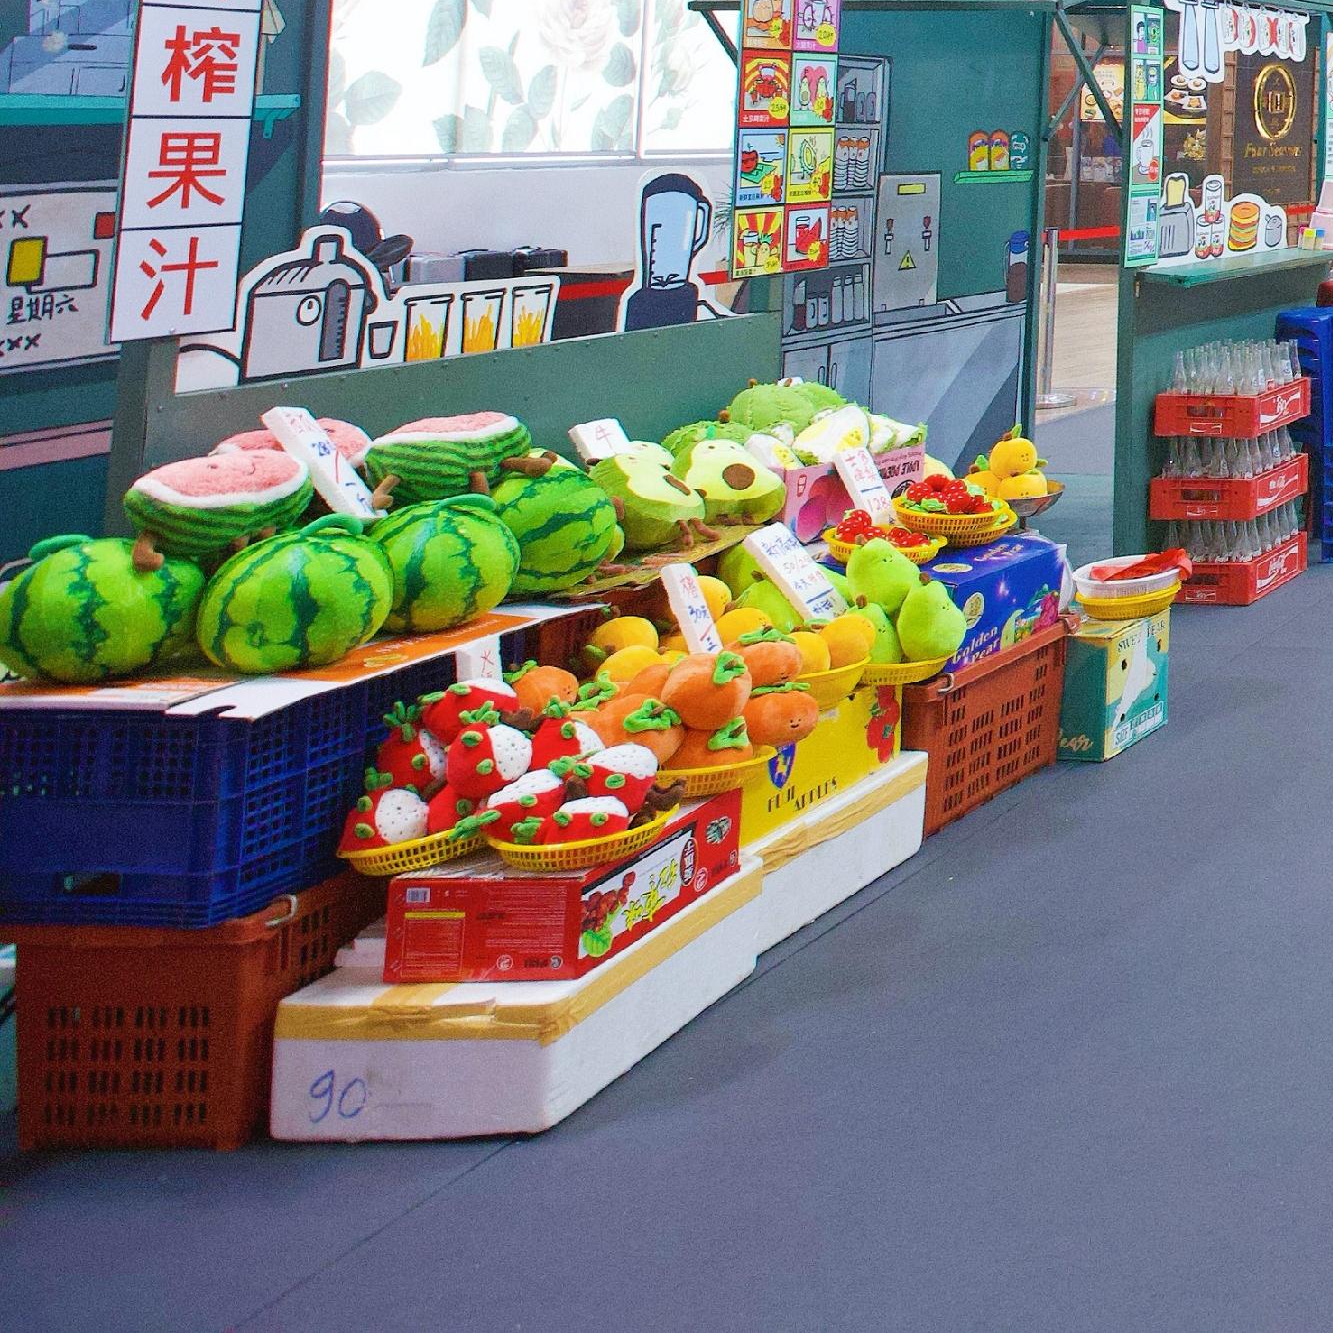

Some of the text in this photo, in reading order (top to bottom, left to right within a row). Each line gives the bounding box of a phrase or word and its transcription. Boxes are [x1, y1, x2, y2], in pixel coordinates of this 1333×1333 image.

[6, 294, 79, 325] 星期六
[953, 626, 999, 664] Golden
[308, 1069, 369, 1122] 90
